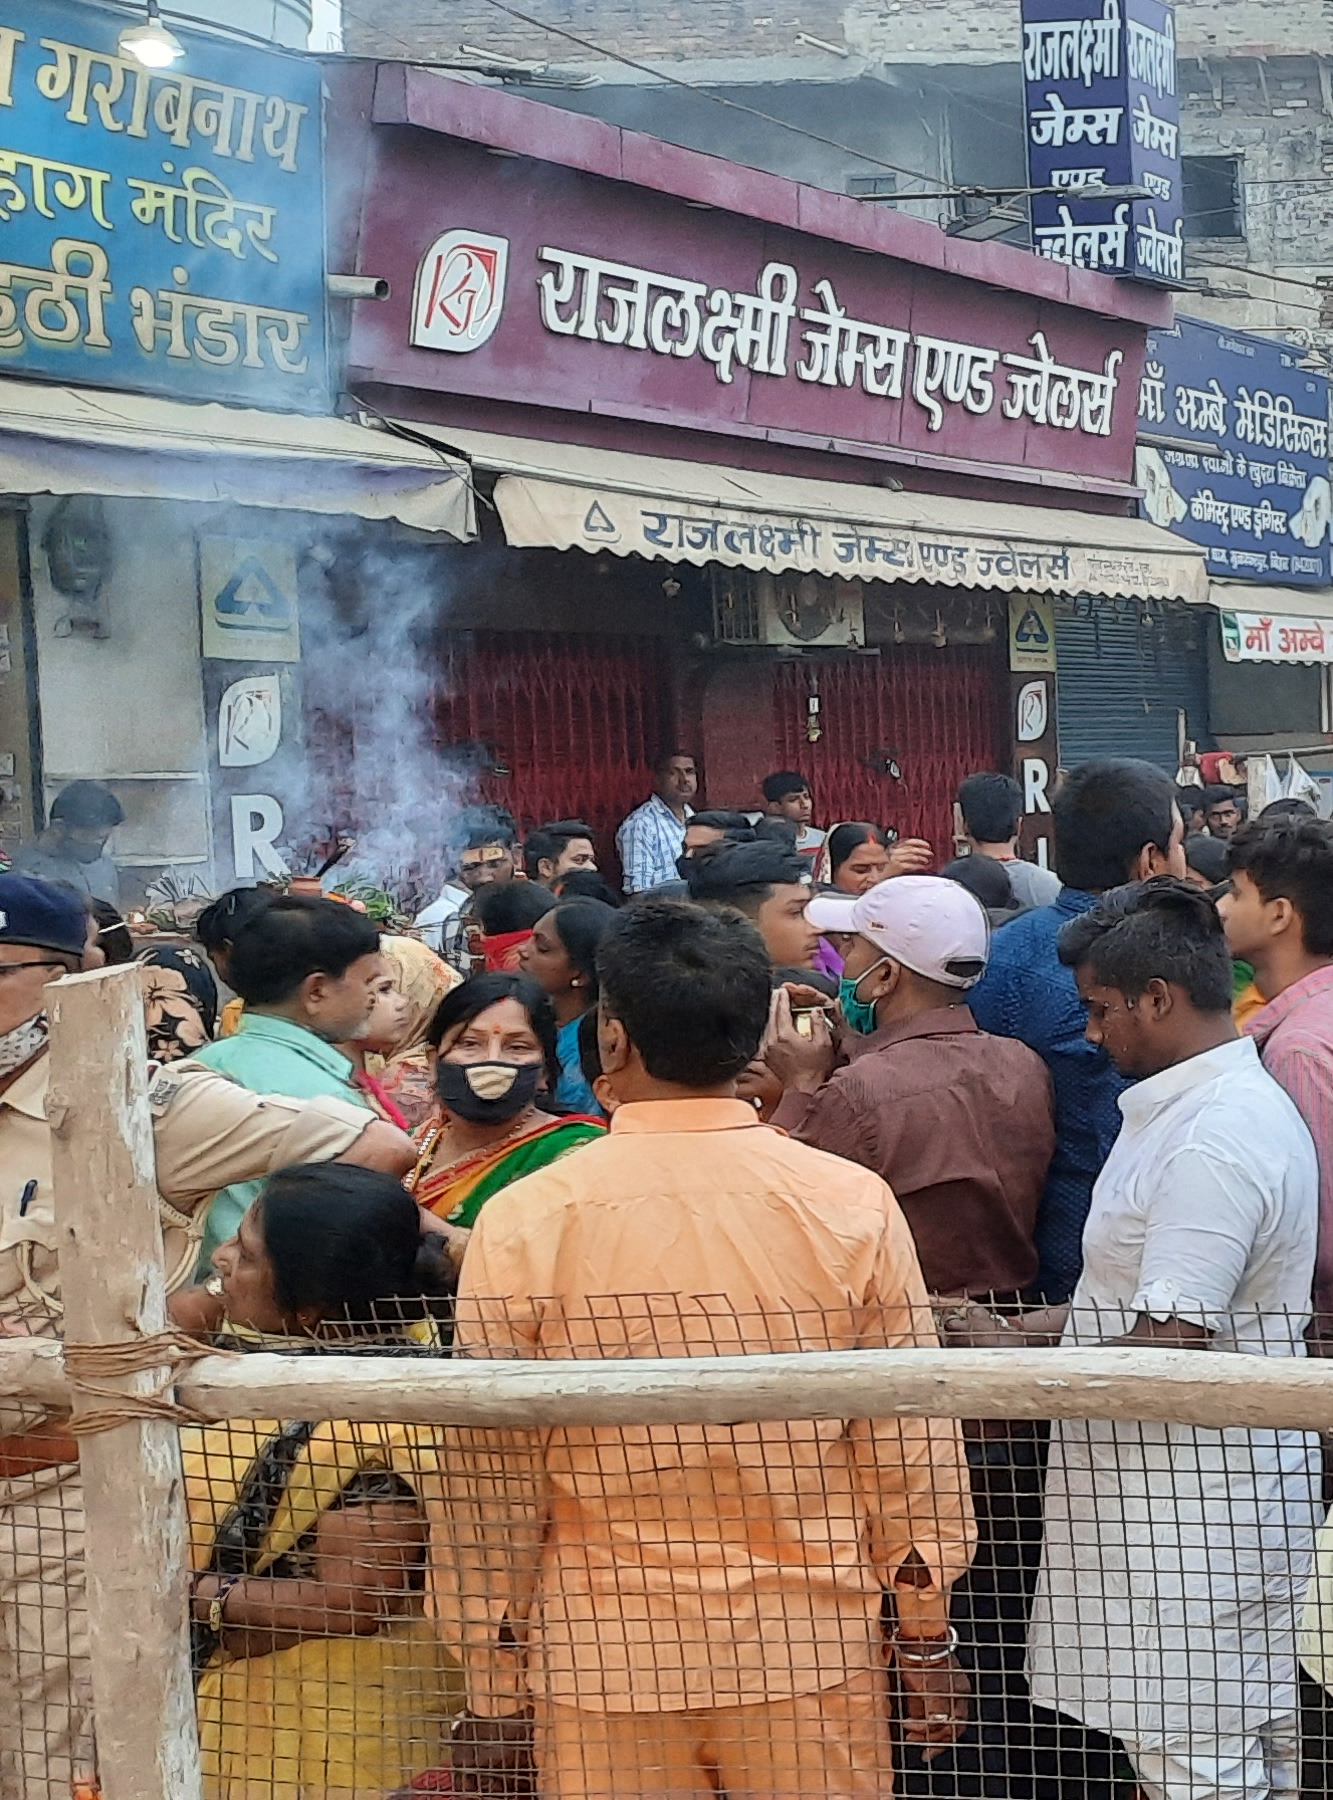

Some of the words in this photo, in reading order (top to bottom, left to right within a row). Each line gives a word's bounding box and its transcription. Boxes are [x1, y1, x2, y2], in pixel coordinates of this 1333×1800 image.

[1024, 0, 1122, 87] राजलक्ष्मी
[1126, 13, 1177, 98] राजलक्ष्मी
[1030, 93, 1124, 146] जेम्स
[1131, 95, 1178, 160] जेम्स
[126, 160, 279, 263] मंदिर
[1134, 208, 1184, 280] ज्वेलर्स
[129, 266, 310, 374] भंडार
[537, 245, 799, 383] राजलक्ष्मी
[796, 278, 911, 399] जेम्स
[912, 334, 1000, 432] एण्ड
[1002, 330, 1125, 437] ज्वेलर्स
[1175, 378, 1228, 437] अम्बे
[1233, 387, 1328, 459] मेडिसिन्स
[640, 509, 821, 561] राजलक्ष्मी
[832, 524, 914, 569] जेम्स
[917, 541, 969, 581] एण्ड
[975, 541, 1071, 582] ज्वेलर्स
[1244, 616, 1273, 653] माँ
[1277, 621, 1325, 655] अम्बे
